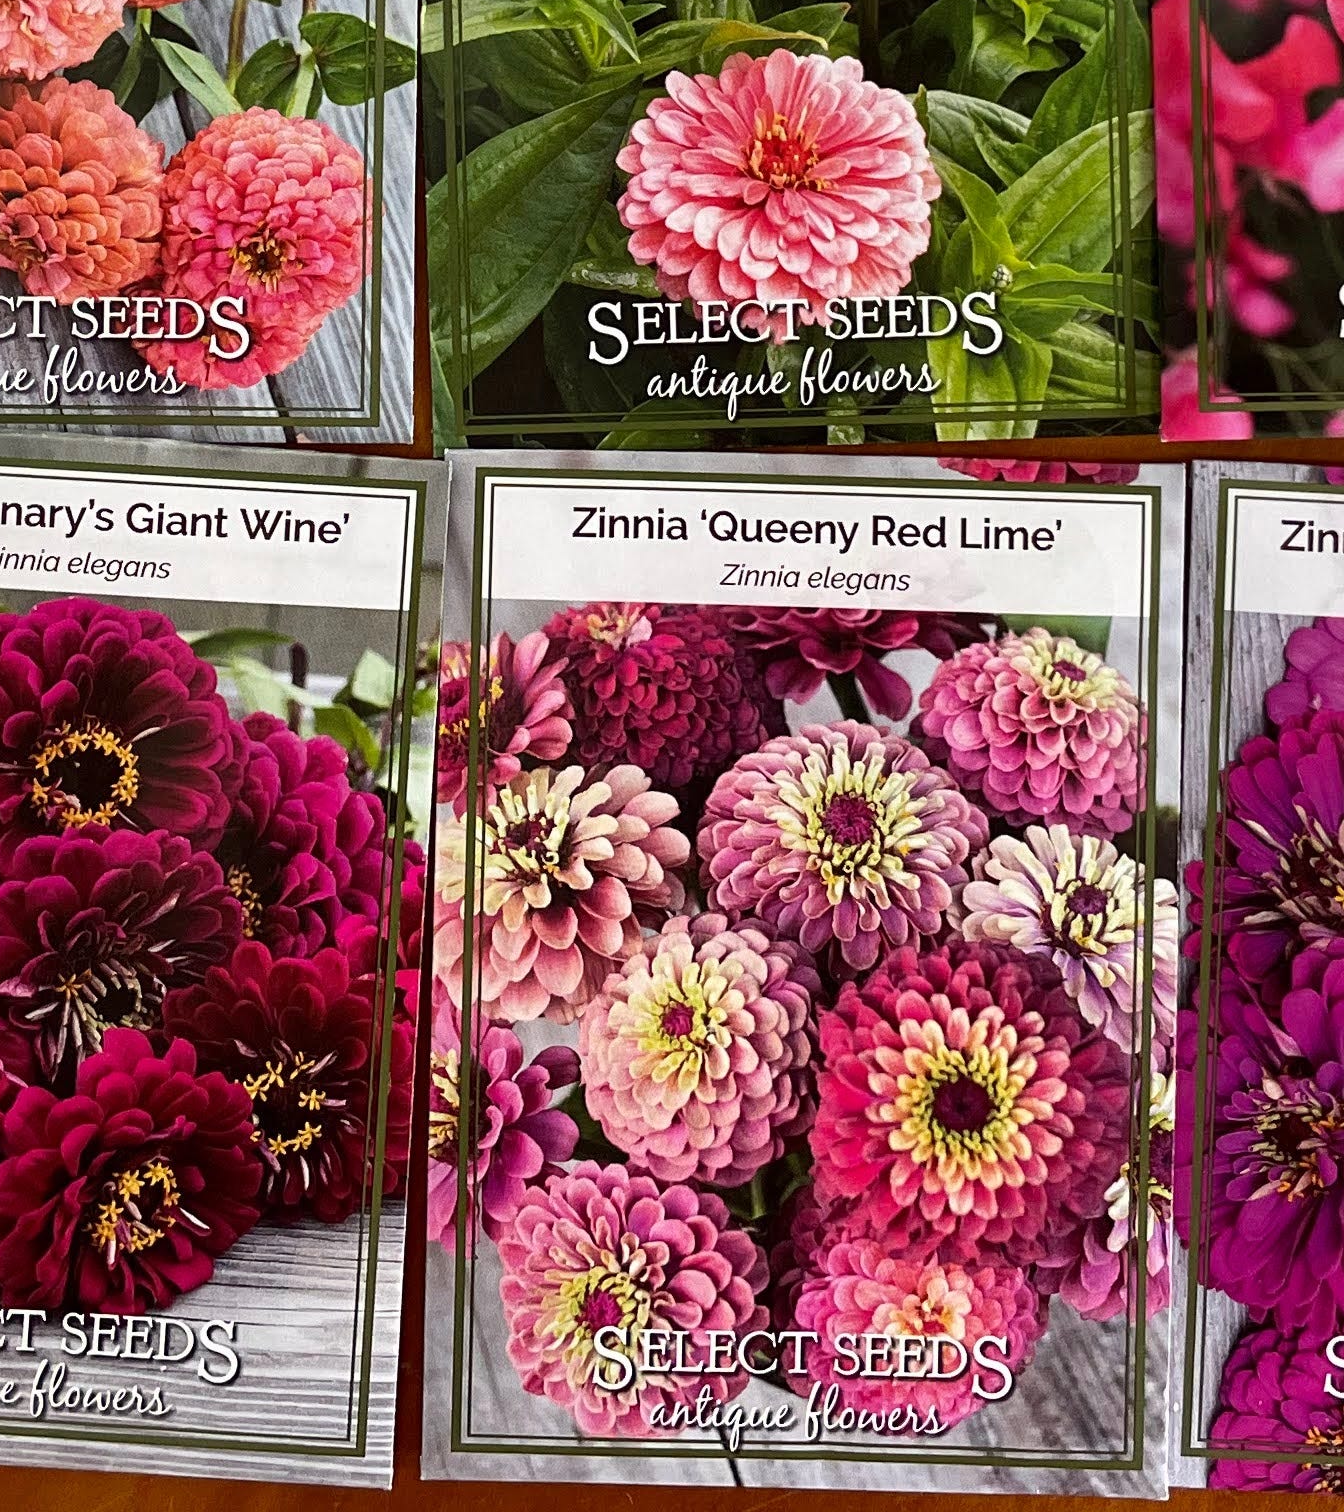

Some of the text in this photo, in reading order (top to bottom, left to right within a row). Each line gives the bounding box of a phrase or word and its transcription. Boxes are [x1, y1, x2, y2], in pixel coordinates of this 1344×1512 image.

[71, 295, 250, 359] SEEDS
[588, 292, 1004, 364] SELECT SEEDS
[44, 346, 187, 404] flowers
[647, 347, 942, 421] antique flowers
[127, 502, 228, 538] Giant
[240, 508, 350, 544] Wine’
[572, 507, 1062, 554] Zinnia ‘Queeny Red Lime’
[68, 552, 171, 580] elegans
[720, 564, 910, 594] Zinnia elegans
[60, 1312, 239, 1384] SEEDS
[592, 1326, 1013, 1400] SELECT SEEDS
[29, 1360, 172, 1418] flowers
[649, 1381, 948, 1450] antique flowers
